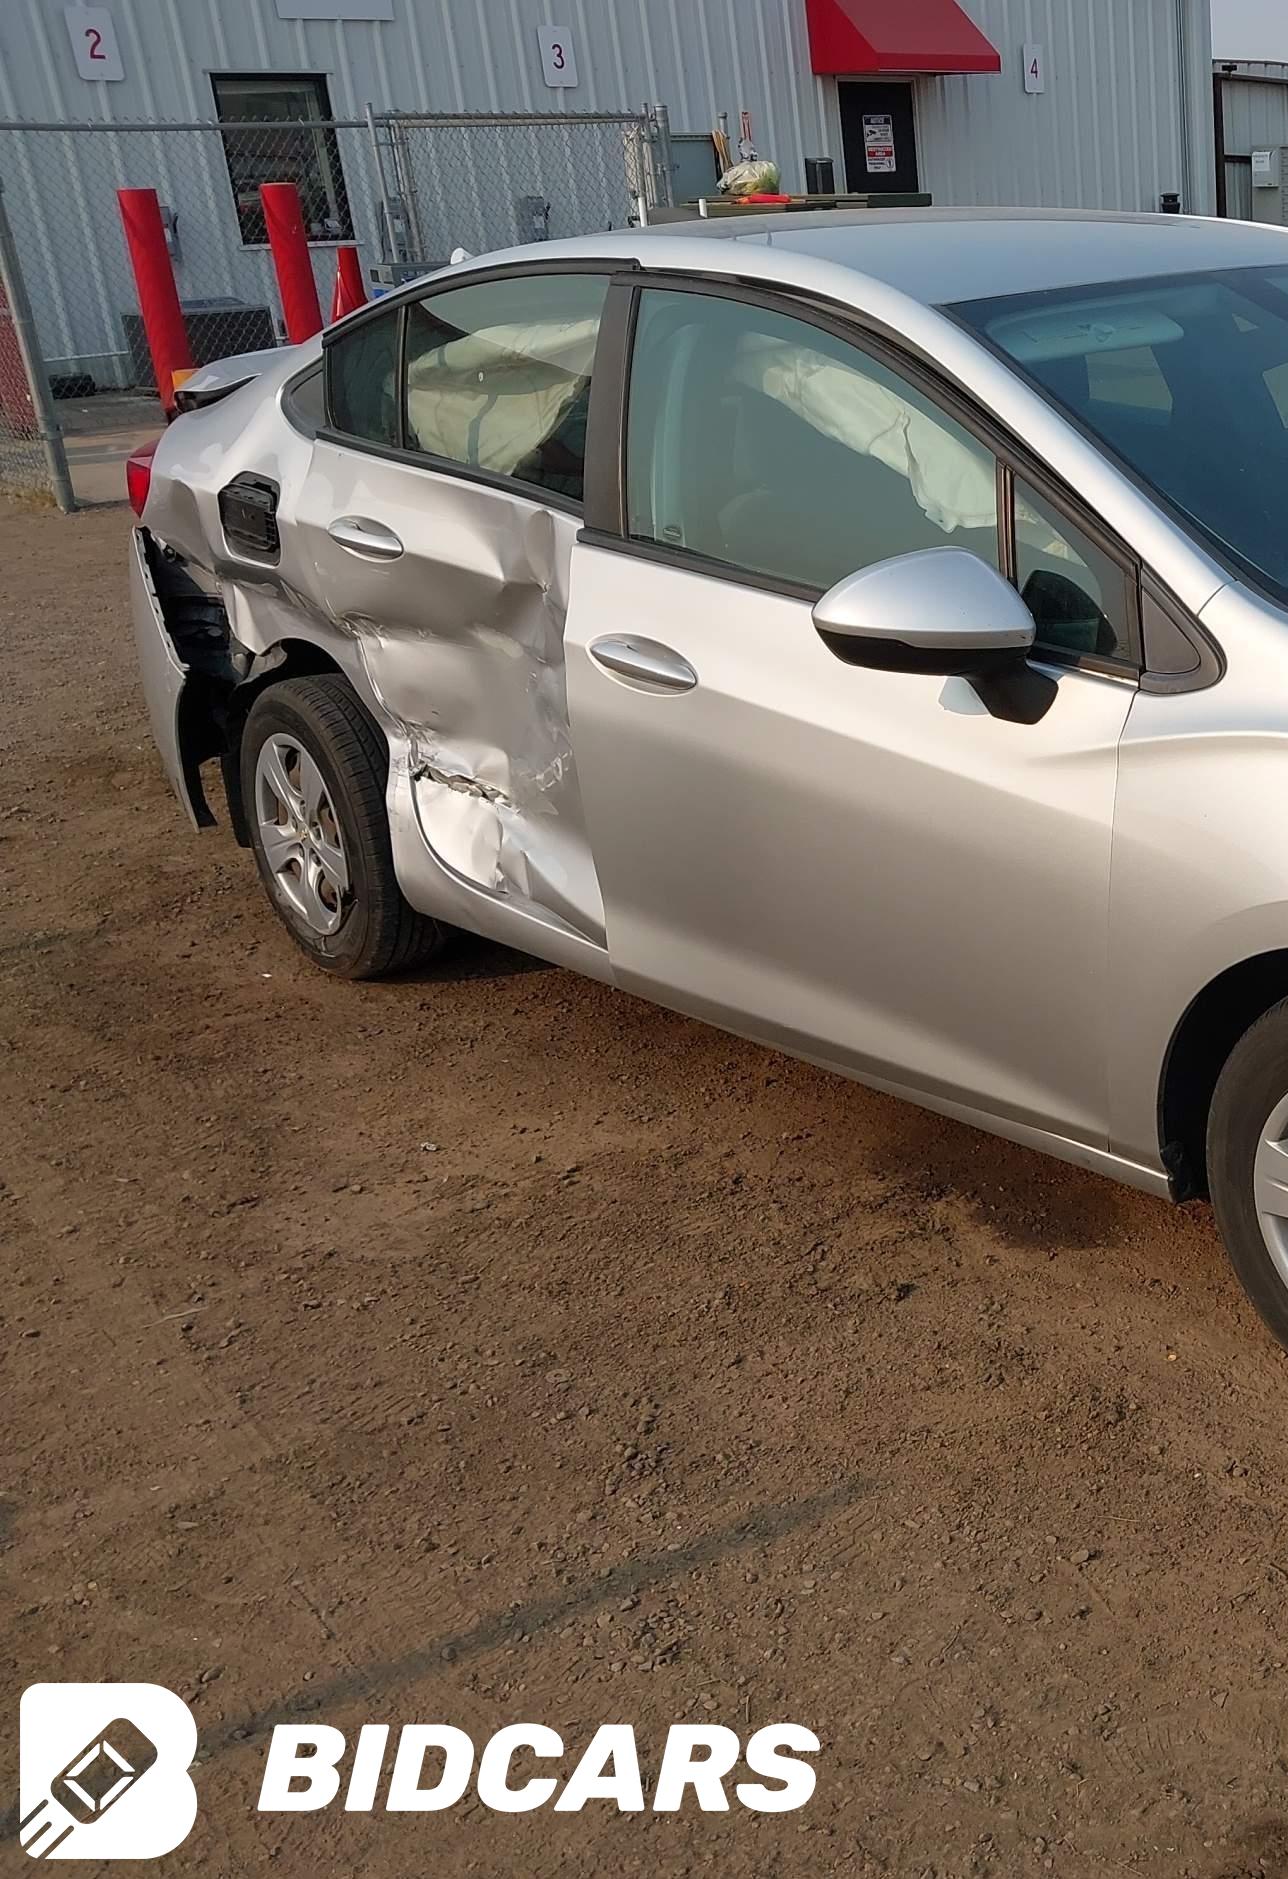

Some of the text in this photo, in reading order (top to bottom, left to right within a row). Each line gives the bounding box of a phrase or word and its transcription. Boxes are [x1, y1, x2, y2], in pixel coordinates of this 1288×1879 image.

[84, 28, 106, 60] 2
[551, 43, 565, 70] 3
[1030, 57, 1038, 79] 4
